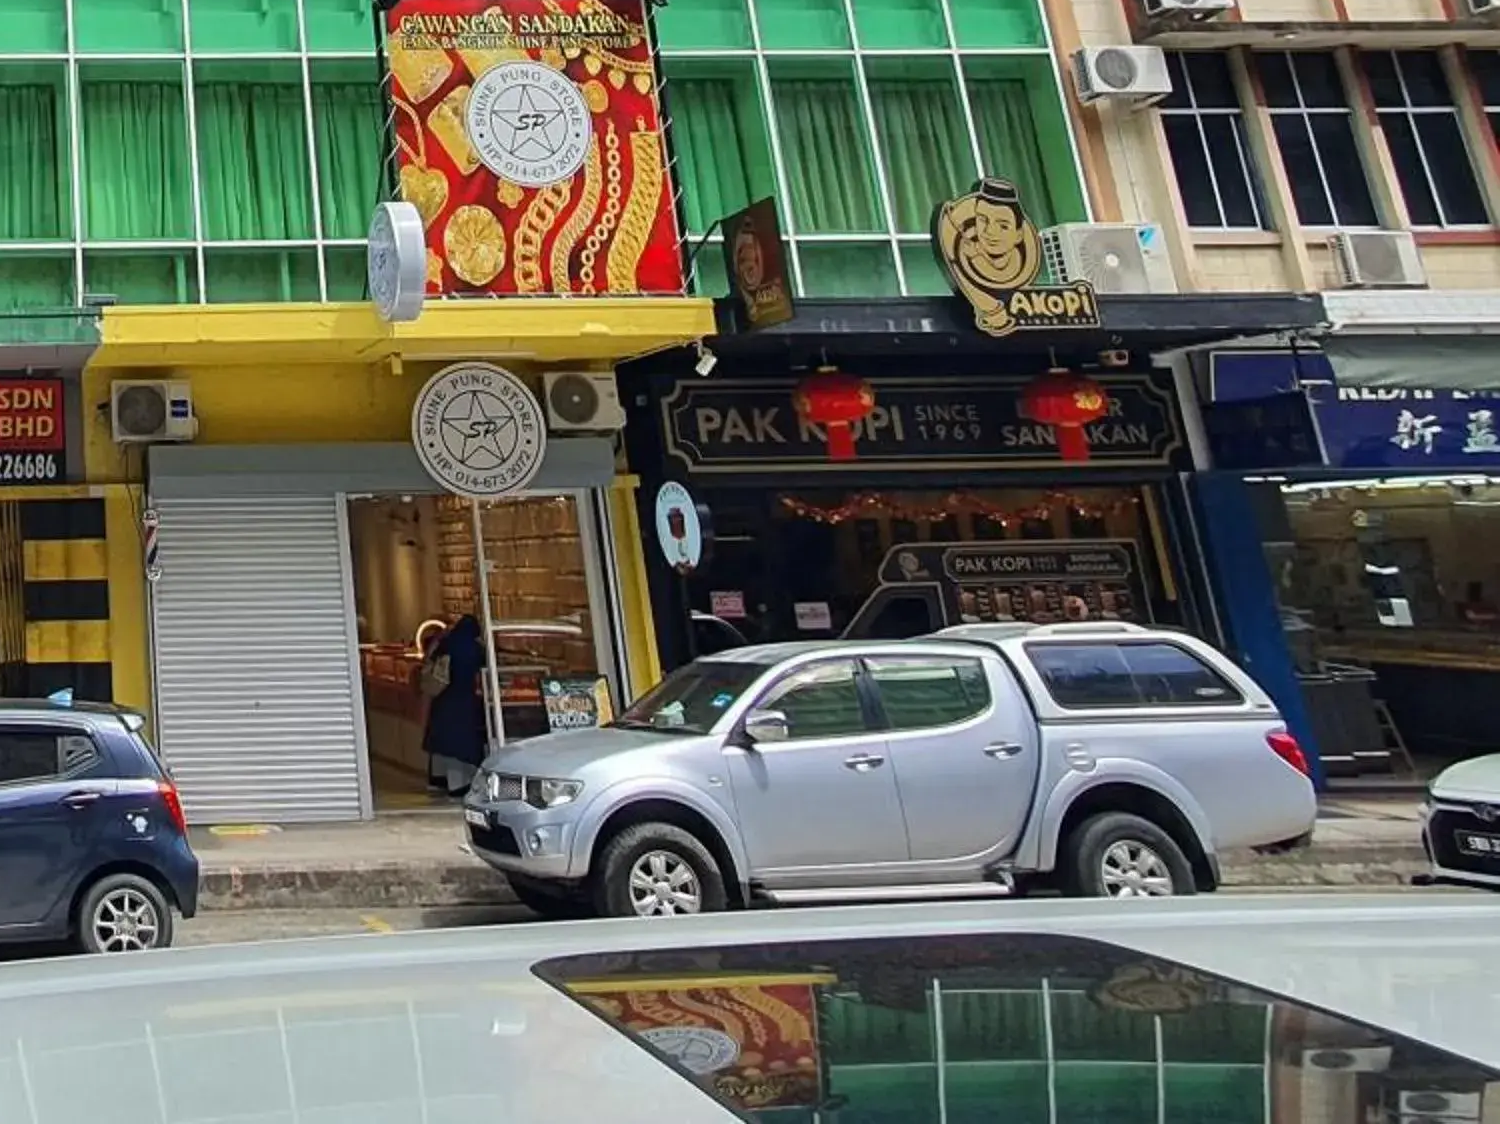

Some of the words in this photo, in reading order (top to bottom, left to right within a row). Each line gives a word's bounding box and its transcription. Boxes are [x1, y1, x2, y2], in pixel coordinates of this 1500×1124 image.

[401, 14, 513, 34] CAWANGAN
[519, 14, 630, 34] SANDAKAN
[475, 82, 497, 127] SHINE
[500, 68, 541, 84] PUNG
[550, 79, 582, 126] STORE
[515, 114, 546, 131] SP
[425, 389, 447, 436] SHINE
[450, 375, 492, 389] PUNG
[500, 385, 533, 433] STORE
[914, 405, 980, 422] SINCE
[466, 422, 497, 438] SP
[696, 407, 787, 443] PAK
[800, 405, 905, 443] KPI
[918, 425, 983, 440] 1969
[1001, 425, 1150, 446] SANKAN
[507, 450, 532, 477] 2072
[955, 557, 988, 573] PAK
